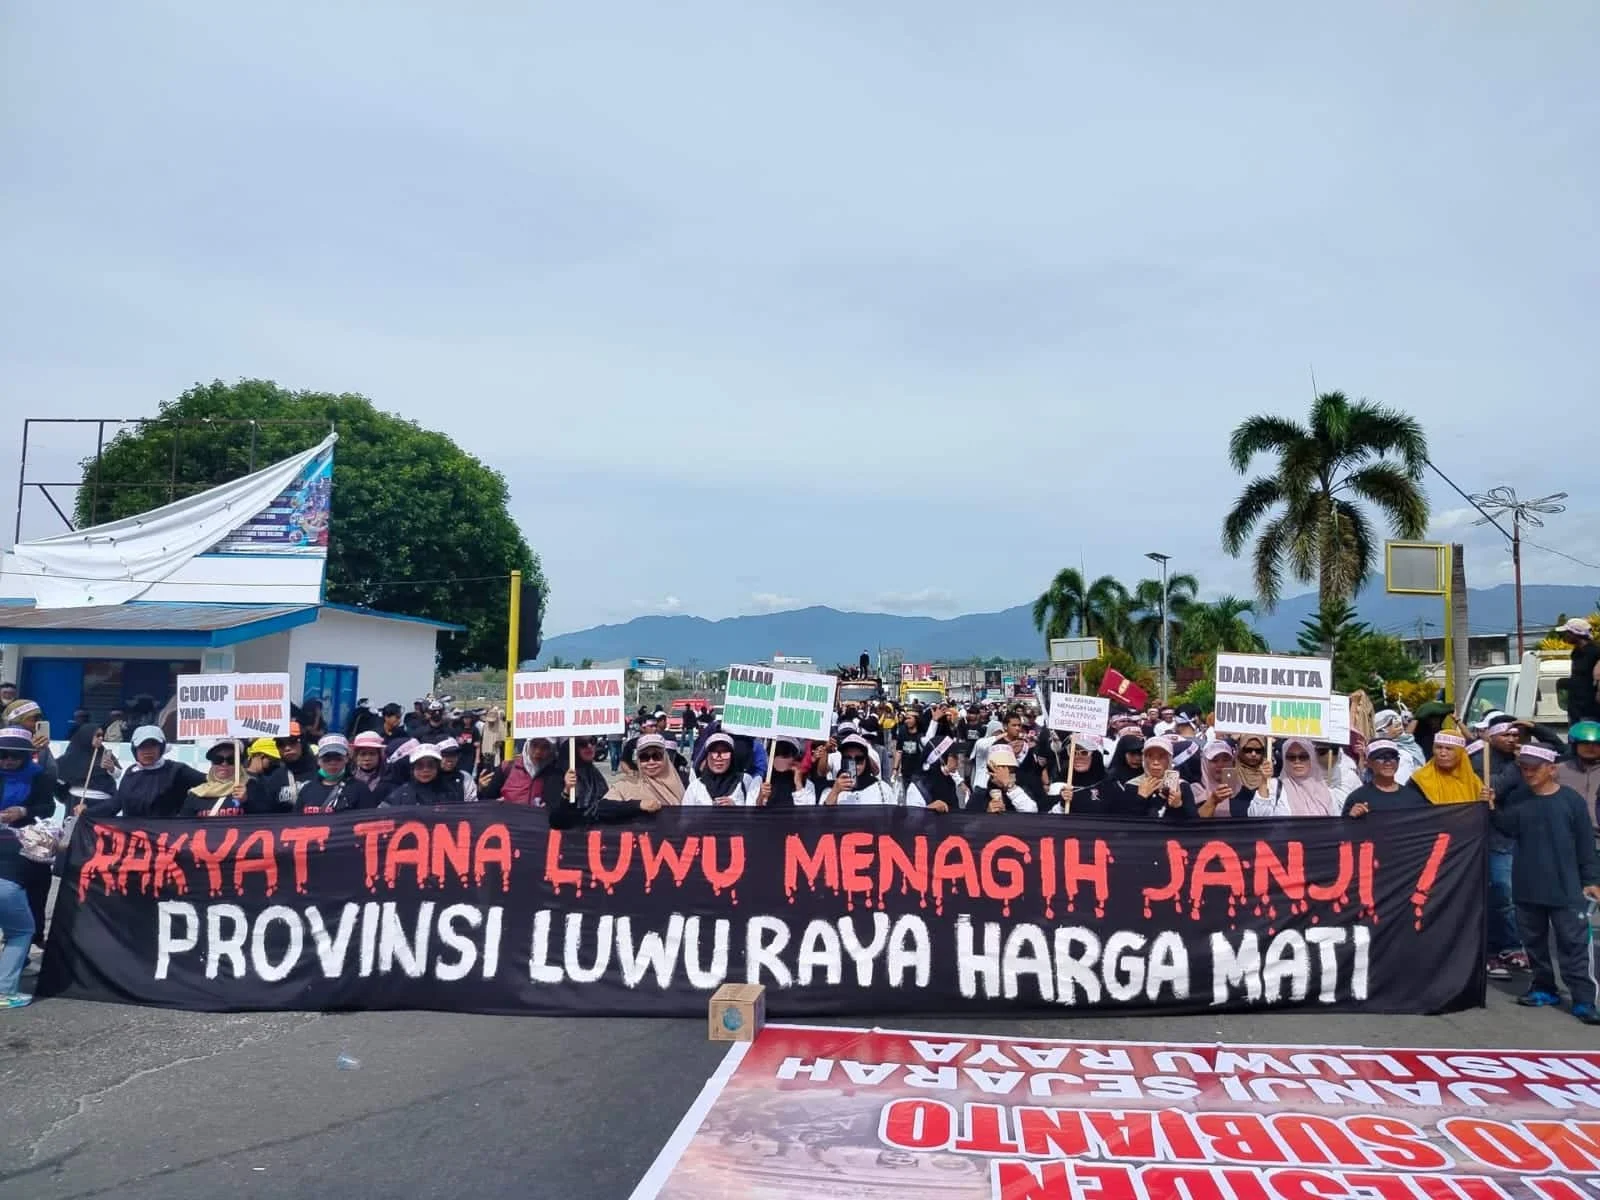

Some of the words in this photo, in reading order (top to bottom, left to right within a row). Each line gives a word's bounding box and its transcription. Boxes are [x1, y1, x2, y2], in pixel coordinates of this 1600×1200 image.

[730, 667, 774, 685] KALAU
[1219, 666, 1268, 685] DARI
[1271, 668, 1323, 688] KITA
[179, 685, 229, 702] CUKUP
[515, 681, 564, 700] LUWU
[572, 679, 620, 697] RAYA
[180, 707, 206, 720] YANG
[234, 705, 260, 720] LUWU
[261, 703, 283, 719] RAYA
[515, 710, 565, 729] MENAGIH
[573, 708, 620, 726] JANJI
[1216, 701, 1267, 725] UNTUK
[1271, 700, 1322, 720] LUWU
[179, 718, 229, 737] DITUNDA
[241, 717, 280, 735] JANGAN
[78, 823, 331, 899] RAKYAT
[352, 819, 513, 890] TANA
[543, 829, 745, 899] LUWU
[783, 832, 1110, 914] MENAGIH
[1142, 838, 1377, 920] JANJI
[1410, 833, 1451, 924] !
[154, 900, 503, 981] PROVINSI
[529, 910, 731, 989] LUWU
[745, 911, 931, 988] RAYA
[954, 913, 1191, 1005] HARGA
[1208, 926, 1371, 1007] MATI
[909, 1039, 1136, 1072] RAYA
[1152, 1050, 1415, 1077] LUWU
[776, 1057, 1202, 1100] SEJARAH
[1221, 1075, 1511, 1107] JANJI
[878, 1098, 1455, 1171] SUBIANTO
